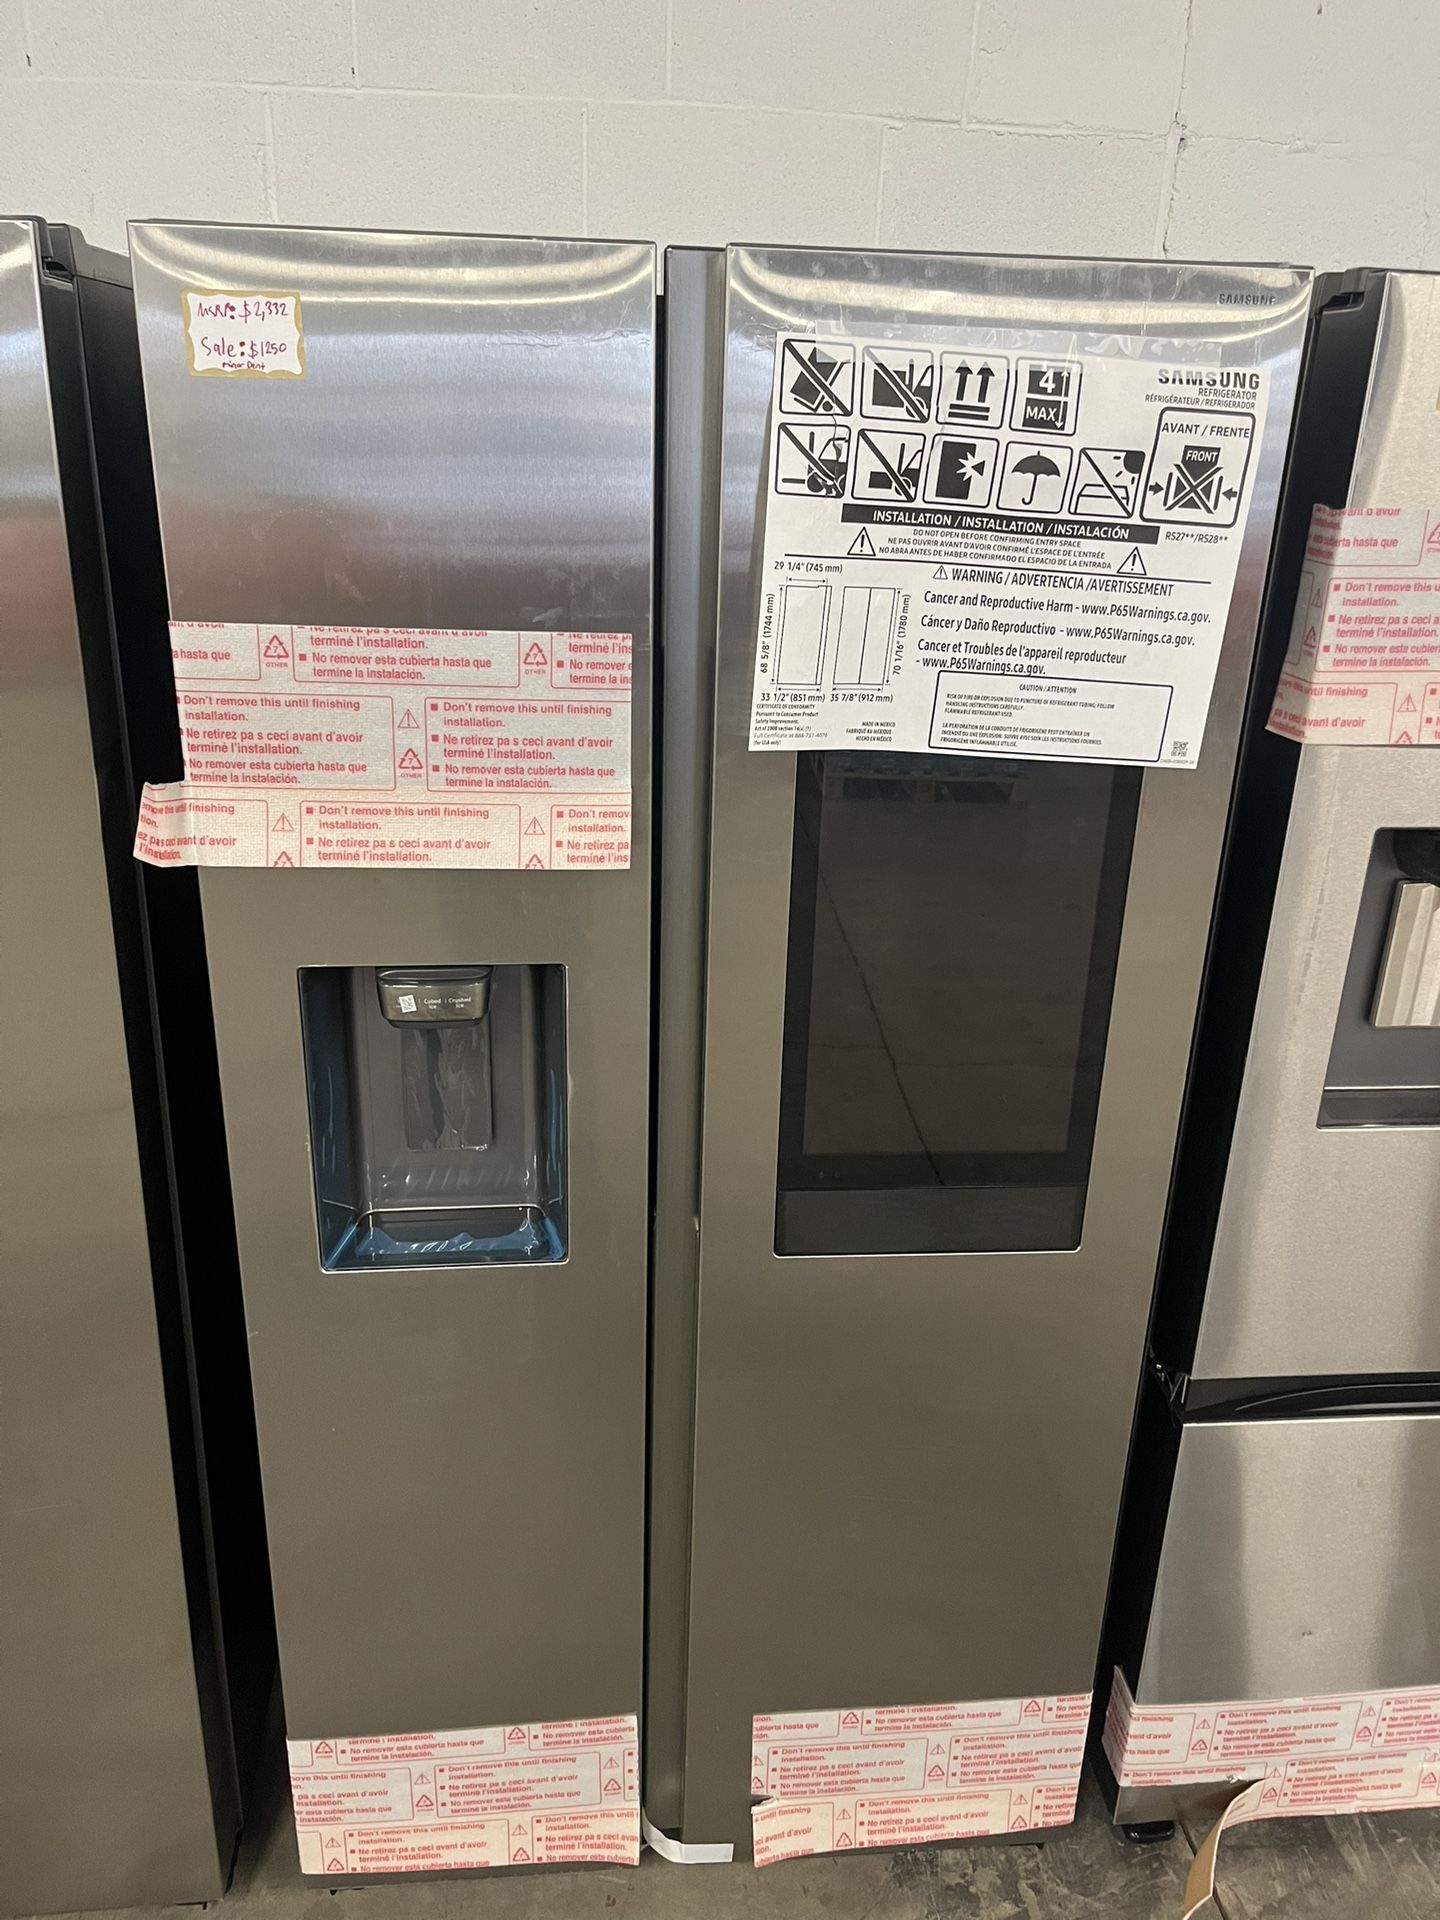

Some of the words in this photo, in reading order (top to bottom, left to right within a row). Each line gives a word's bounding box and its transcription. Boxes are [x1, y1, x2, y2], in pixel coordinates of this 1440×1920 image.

[1039, 367, 1056, 394] 4
[1158, 369, 1260, 390] SAMSUNG
[1145, 393, 1200, 406] RÉFRIGÉRATEUR
[1205, 398, 1256, 410] REFRIGERADOR
[1198, 387, 1257, 401] REFRIGERATOR
[1025, 405, 1058, 421] MAX
[1161, 422, 1200, 435] AVANT
[1209, 425, 1250, 439] FRENTE
[1185, 450, 1219, 463] FRONT
[872, 510, 951, 526] INSTALLATION
[774, 560, 785, 570] 29
[805, 561, 824, 573] (745
[824, 563, 843, 574] mm)
[952, 568, 1004, 585] WARNING
[1010, 572, 1084, 590] ADVERTENCIA
[1344, 582, 1373, 593] Don't
[1373, 583, 1412, 592] remove
[1413, 582, 1431, 592] this
[766, 593, 776, 614] mm)
[901, 594, 912, 614] mm)
[923, 590, 959, 605] Cancer
[959, 593, 979, 607] and
[979, 594, 1045, 611] Reproductive
[1045, 598, 1074, 613] Harm
[1081, 603, 1211, 626] www.P65Warnings.ca.gov.
[1342, 596, 1400, 607] installation.
[763, 615, 773, 638] (1744
[897, 615, 908, 639] (1780
[920, 614, 956, 629] Cáncer
[955, 619, 963, 633] y
[963, 617, 990, 632] Daño
[991, 619, 1057, 636] Reproductivo
[1066, 626, 1195, 648] www.P65Warnings.ca.gov.
[1335, 627, 1375, 638] terminé
[1376, 627, 1440, 639] l'installation.
[310, 635, 354, 647] terminé
[356, 635, 429, 649] l'installation.
[917, 638, 952, 653] Cancer
[951, 641, 963, 654] et
[964, 641, 1005, 656] Troubles
[1005, 643, 1018, 657] de
[1018, 644, 1064, 661] l'appareil
[1064, 650, 1127, 664] reproducteur
[312, 651, 327, 664] No
[329, 654, 373, 665] remover
[374, 654, 397, 666] esta
[398, 654, 441, 667] cubierta
[442, 656, 471, 668] hasta
[472, 658, 492, 671] que
[759, 662, 768, 674] 68
[921, 657, 1047, 677] www.P65Warnings.ca.gov.
[312, 666, 353, 678] termine
[354, 667, 364, 679] la
[366, 667, 426, 680] instalación.
[892, 664, 901, 676] 70
[760, 692, 771, 702] 33
[789, 692, 807, 703] (851
[807, 693, 826, 703] mm)
[830, 693, 839, 703] 35
[858, 692, 875, 703] (912
[875, 693, 894, 704] mm)
[443, 701, 472, 712] Don't
[474, 704, 515, 714] remove
[517, 703, 538, 714] this
[540, 704, 564, 714] until
[566, 704, 612, 718] finishing
[443, 716, 506, 728] installation.
[443, 733, 458, 745] Ne
[460, 734, 494, 746] retirez
[496, 737, 510, 749] pa
[511, 737, 519, 746] s
[521, 735, 544, 748] ceci
[546, 737, 575, 747] avant
[577, 736, 614, 748] d'avoir
[443, 747, 485, 759] terminé
[487, 747, 556, 760] l'installation.
[444, 763, 460, 775] No
[461, 765, 502, 775] remover
[503, 765, 525, 777] esta
[526, 764, 567, 778] cubierta
[568, 766, 596, 777] hasta
[596, 768, 616, 779] que
[445, 776, 483, 788] termine
[484, 777, 494, 788] la
[496, 777, 552, 789] instalación.
